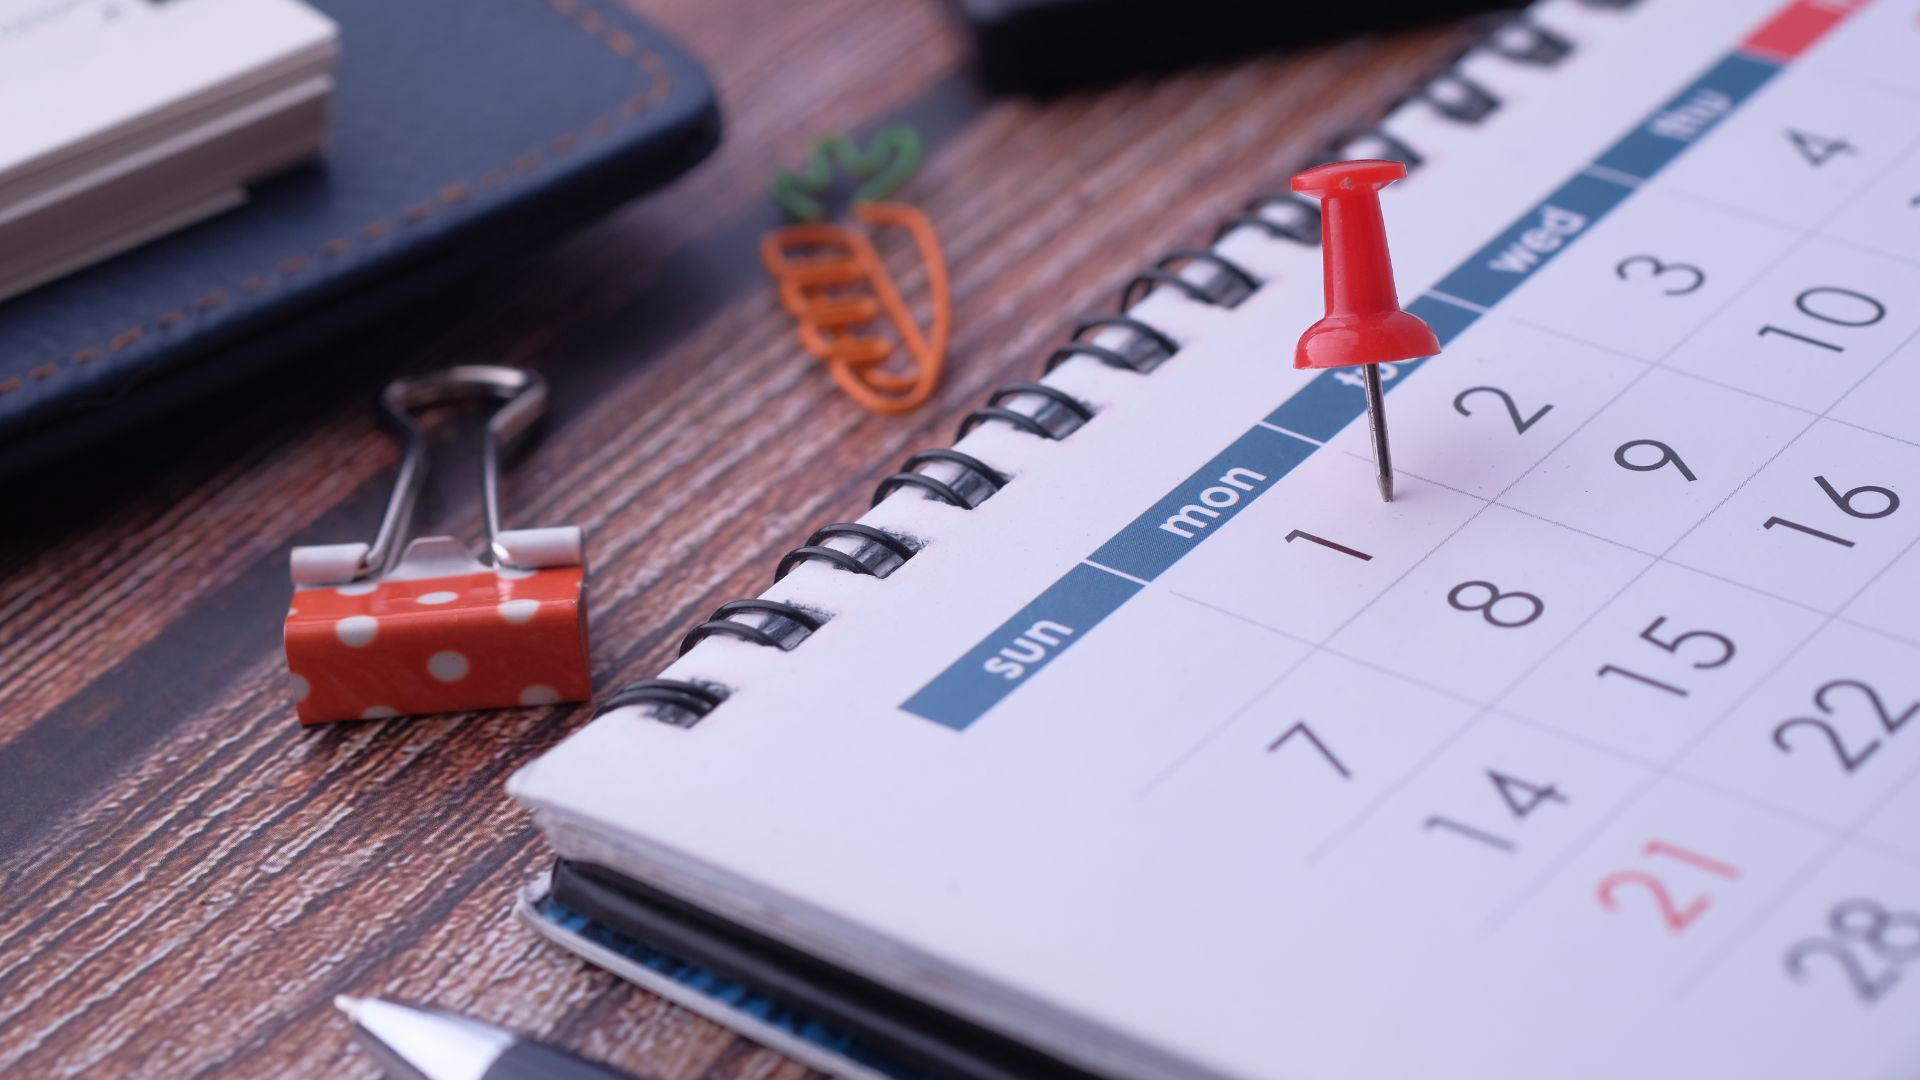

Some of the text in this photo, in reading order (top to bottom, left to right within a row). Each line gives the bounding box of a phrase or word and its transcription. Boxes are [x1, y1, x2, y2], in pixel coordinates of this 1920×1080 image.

[983, 619, 1073, 679] sun
[1159, 466, 1267, 538] mon
[1488, 204, 1586, 273] wed
[1267, 286, 1887, 779] 7 8 9 10
[1284, 129, 1859, 562] 1 2 3 4
[1423, 475, 1901, 852] 14 15 16
[1595, 679, 1920, 936] 21 22
[1783, 897, 1920, 1006] 28
